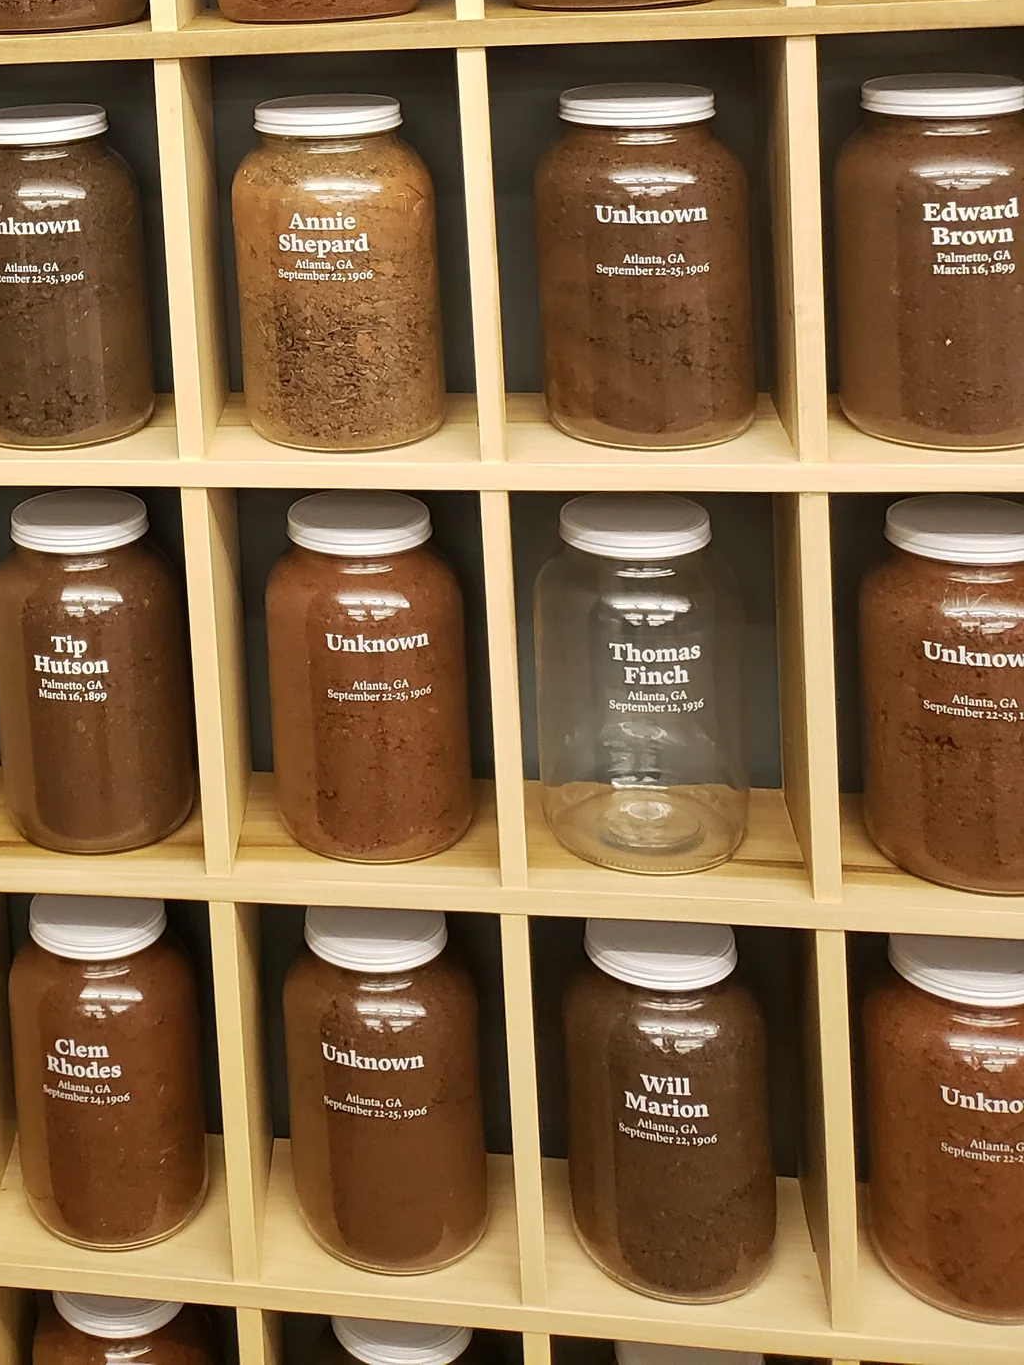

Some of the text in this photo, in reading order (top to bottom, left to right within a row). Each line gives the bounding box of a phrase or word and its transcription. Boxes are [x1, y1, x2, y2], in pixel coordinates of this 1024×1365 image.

[595, 204, 707, 224] Unknown
[923, 198, 1019, 221] Edward
[289, 212, 356, 230] Annie
[931, 227, 1014, 245] Brown
[279, 233, 369, 258] Shepard
[295, 259, 354, 271] Atlanta, GA
[623, 253, 685, 265] Atlanta, GA
[937, 250, 1011, 263] Palmetto, GA
[5, 262, 59, 274] Atlanta, GA
[279, 269, 373, 282] September 22, 1906
[597, 262, 709, 277] September 22-25, 1906
[933, 263, 1015, 275] March 16, 1899
[32, 275, 58, 284] 22-25,
[60, 271, 83, 283] 1906
[51, 635, 87, 658] Tip
[325, 633, 429, 652] Unknown
[609, 643, 700, 662] Thomas
[922, 641, 1024, 667] Unknow
[34, 655, 109, 674] Hutson
[624, 665, 689, 684] Finch
[42, 679, 103, 692] Palmetto, GA
[328, 684, 431, 702] September 22-25, 1906
[352, 679, 409, 691] Atlanta, GA
[39, 689, 107, 702] March 16, 1899
[628, 690, 687, 702] Atlanta, GA
[952, 695, 1018, 709] Atlanta, GA
[610, 698, 704, 713] September 12, 1936
[924, 699, 984, 718] September
[986, 712, 1017, 722] 22-25,
[55, 1039, 109, 1058] Clem
[322, 1042, 424, 1071] Unknown
[47, 1055, 121, 1078] Rhodes
[58, 1080, 111, 1094] Atlanta, GA
[640, 1074, 691, 1095] Will
[91, 1096, 104, 1105] 24,
[107, 1093, 130, 1105] 1906
[324, 1094, 427, 1120] September 22-25, 1906
[346, 1094, 402, 1109] Atlanta, GA
[625, 1091, 709, 1118] Marion
[941, 1086, 1024, 1113] Unkno
[619, 1121, 717, 1146] September 22, 1906
[638, 1118, 698, 1135] Atlanta, GA
[941, 1141, 1001, 1162] September
[970, 1139, 1013, 1153] Atlanta,
